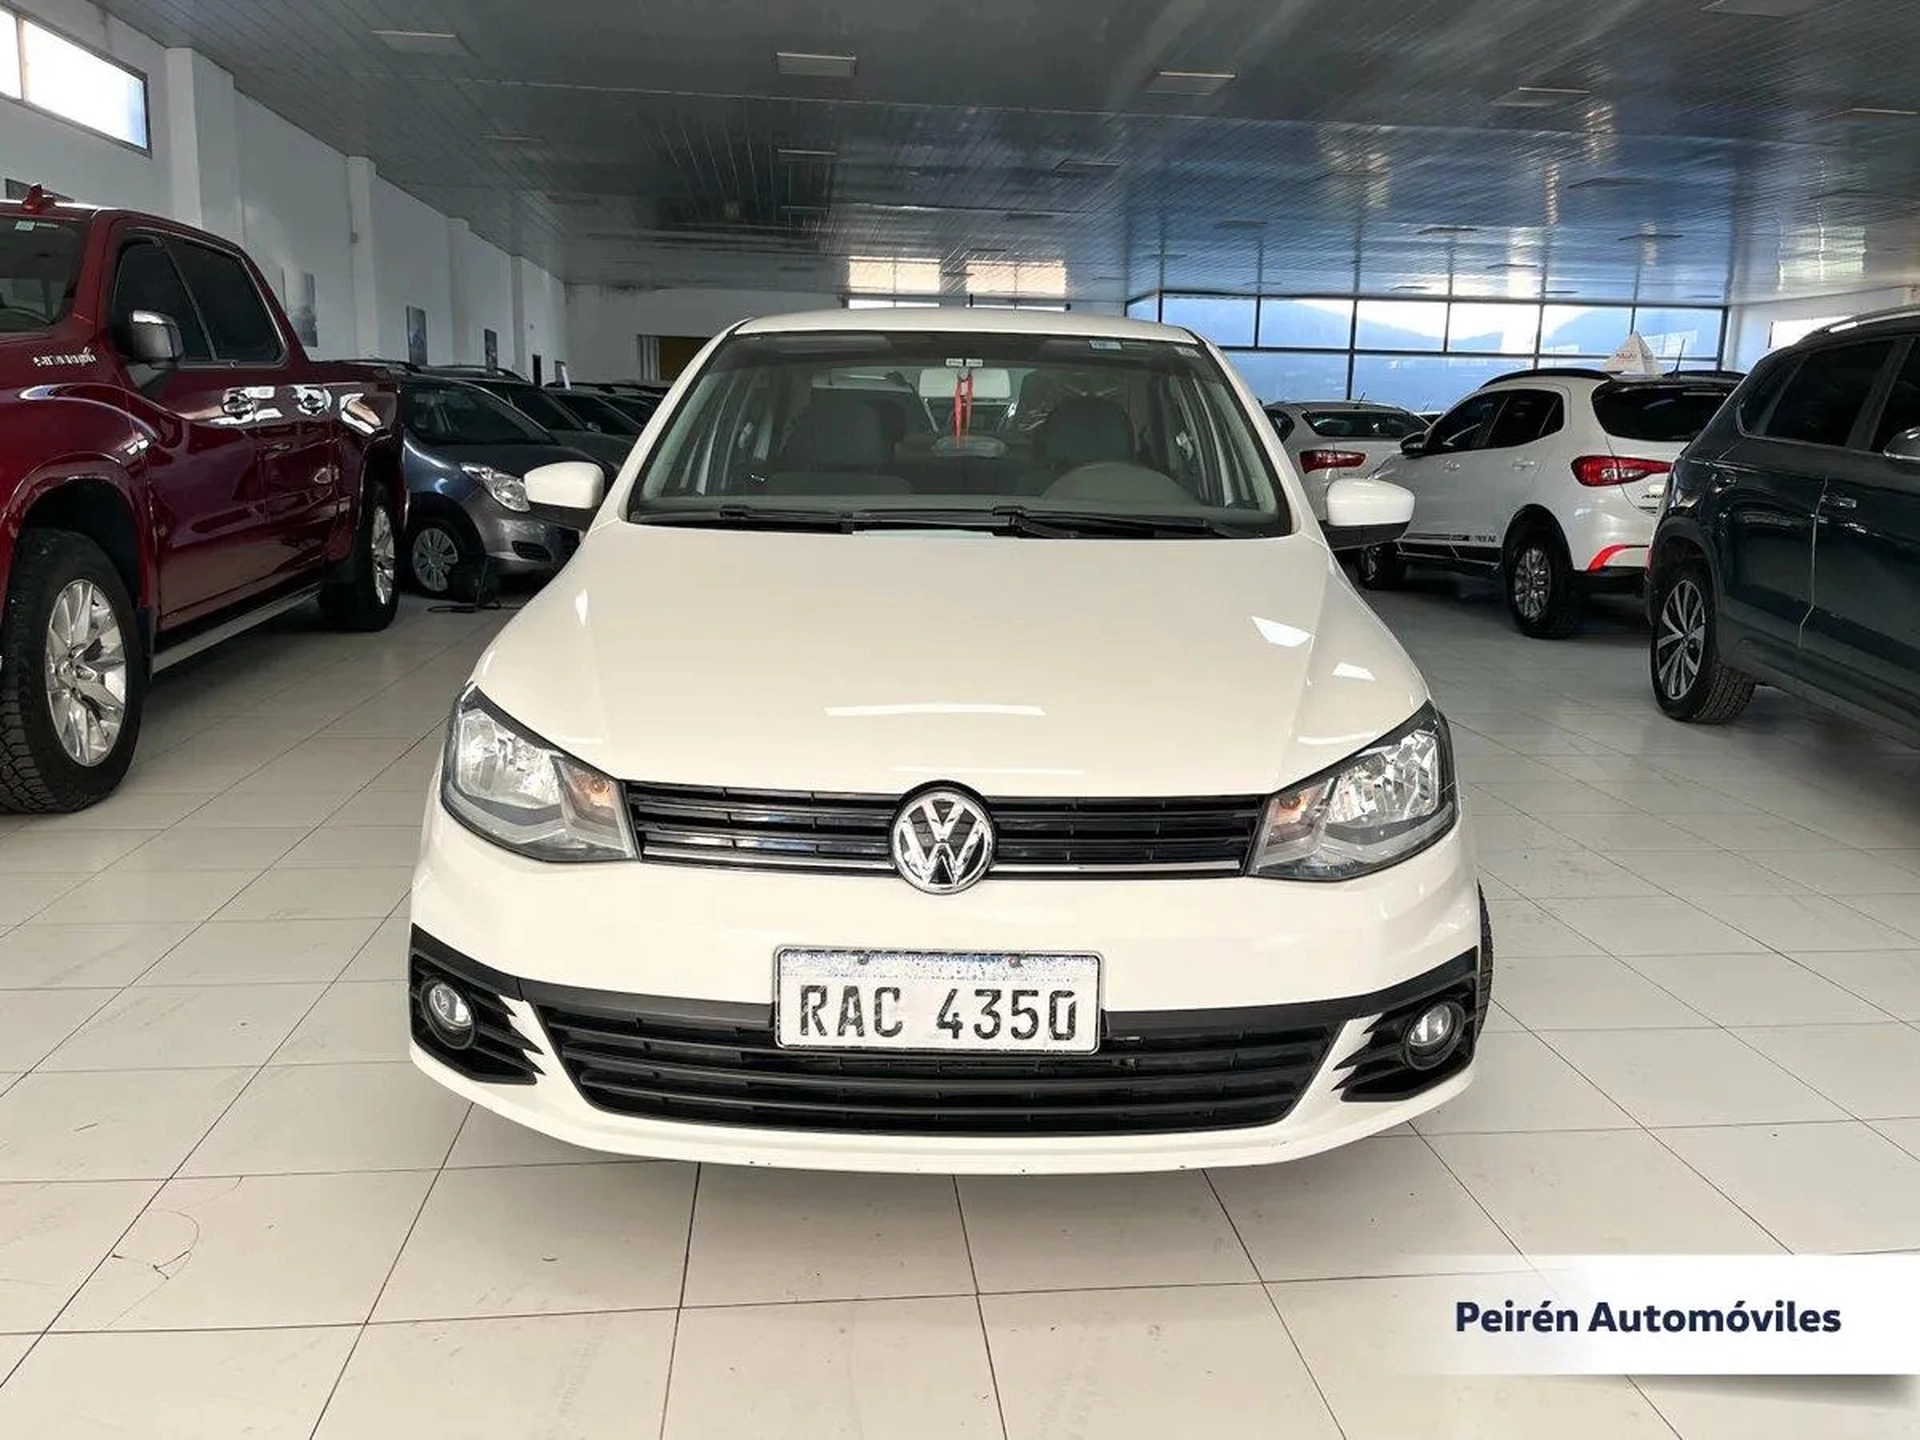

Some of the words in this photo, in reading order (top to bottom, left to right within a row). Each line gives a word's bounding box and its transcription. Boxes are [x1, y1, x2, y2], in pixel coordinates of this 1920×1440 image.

[896, 794, 990, 892] VW
[800, 984, 903, 1037] RAC
[936, 988, 1077, 1041] 4350
